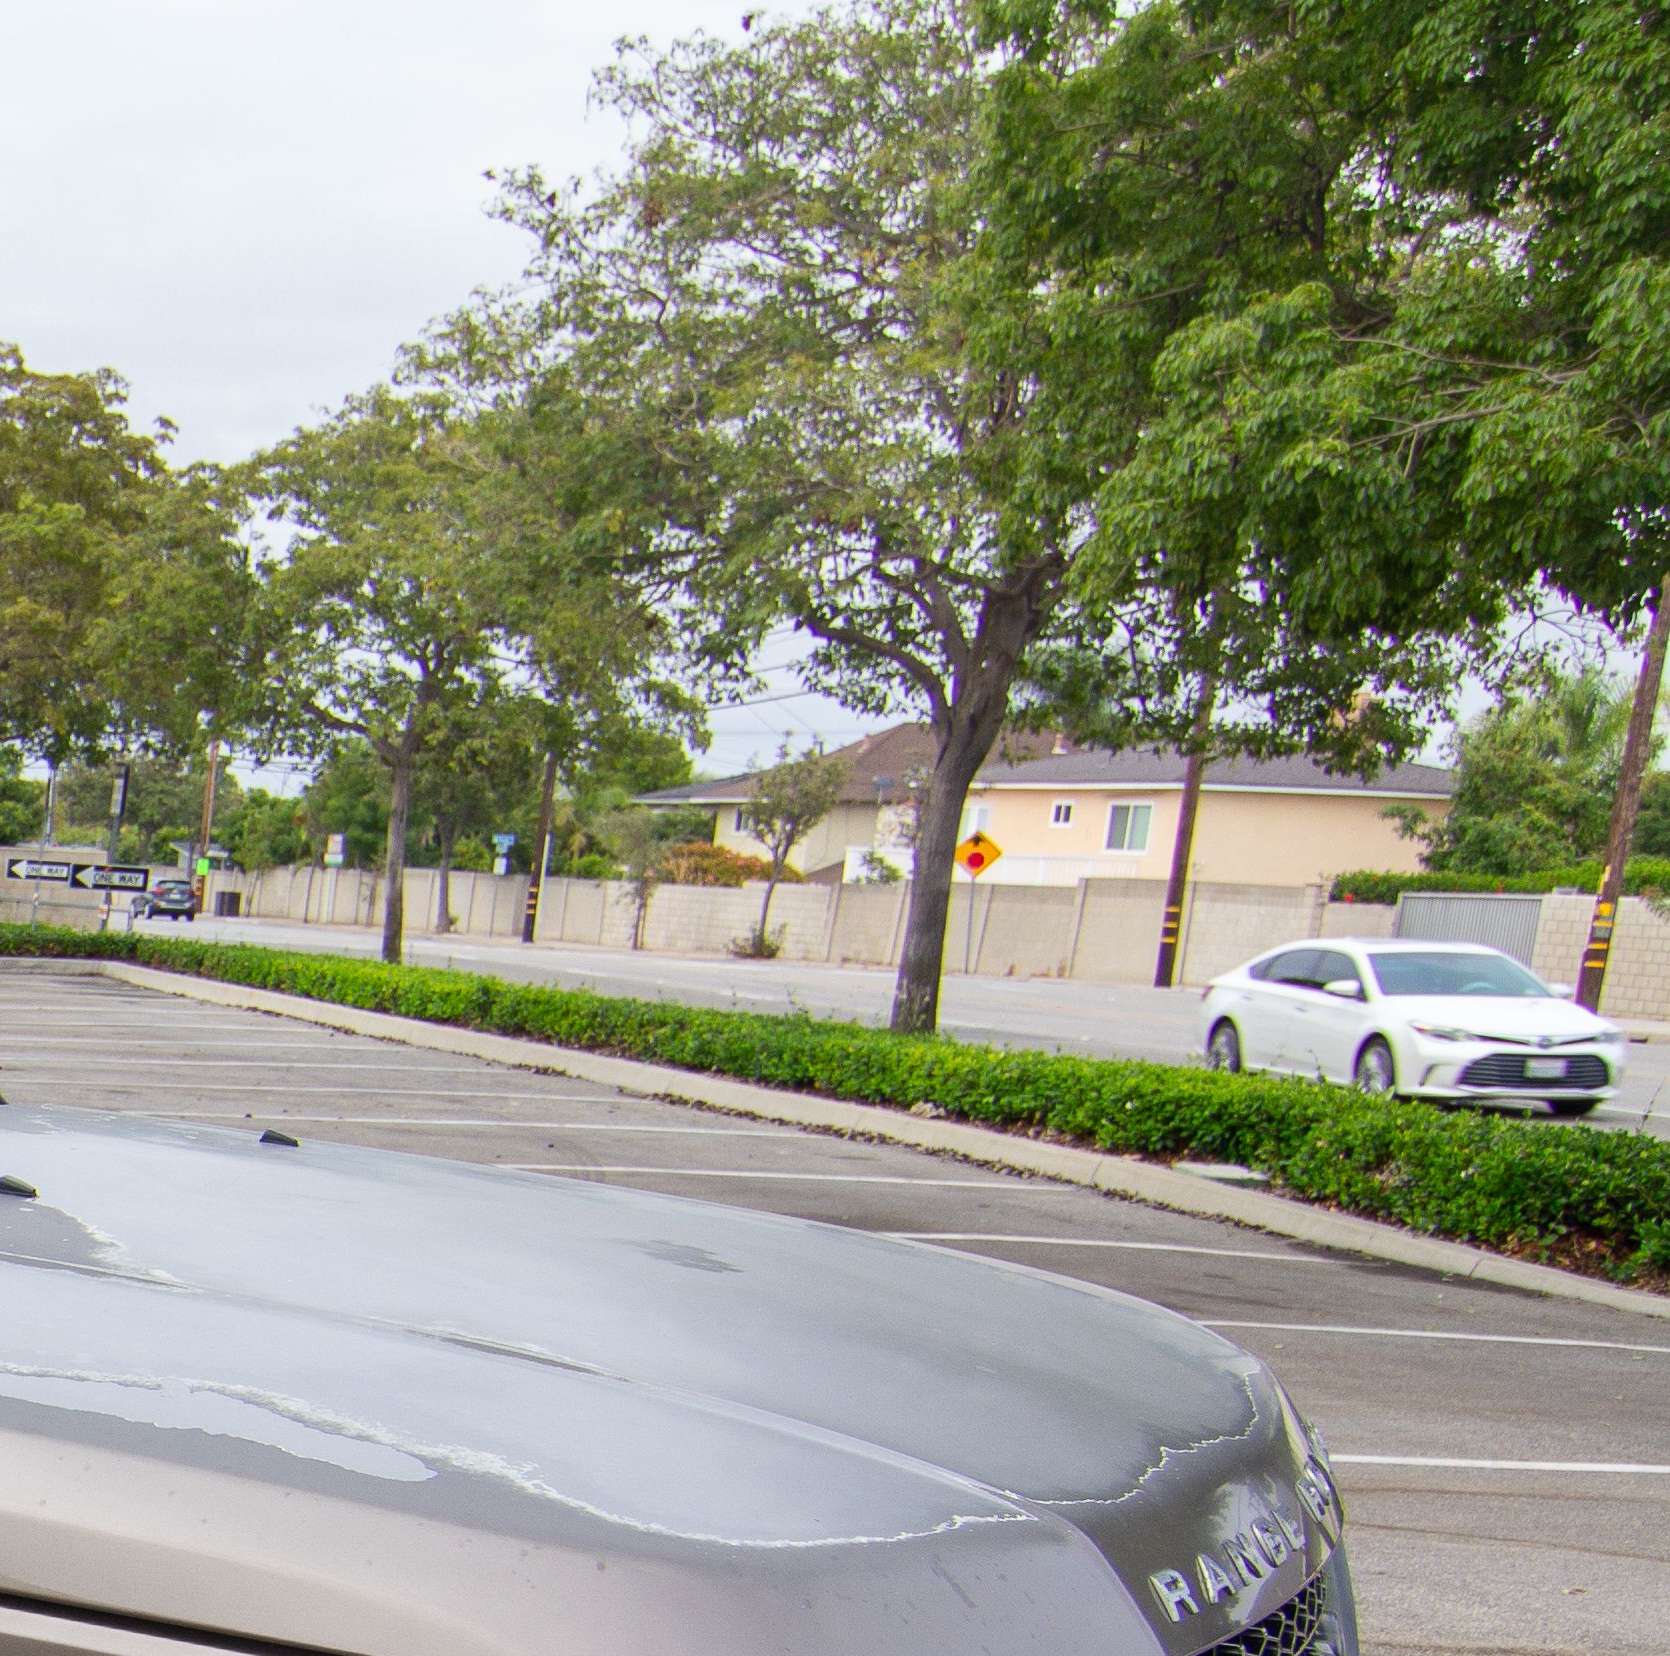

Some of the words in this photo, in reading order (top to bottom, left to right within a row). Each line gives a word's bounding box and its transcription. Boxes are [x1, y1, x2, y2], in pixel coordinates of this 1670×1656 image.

[26, 866, 44, 874] ONE
[93, 873, 115, 884] ONE
[118, 874, 141, 884] WAY
[1148, 1511, 1304, 1622] RANGE
